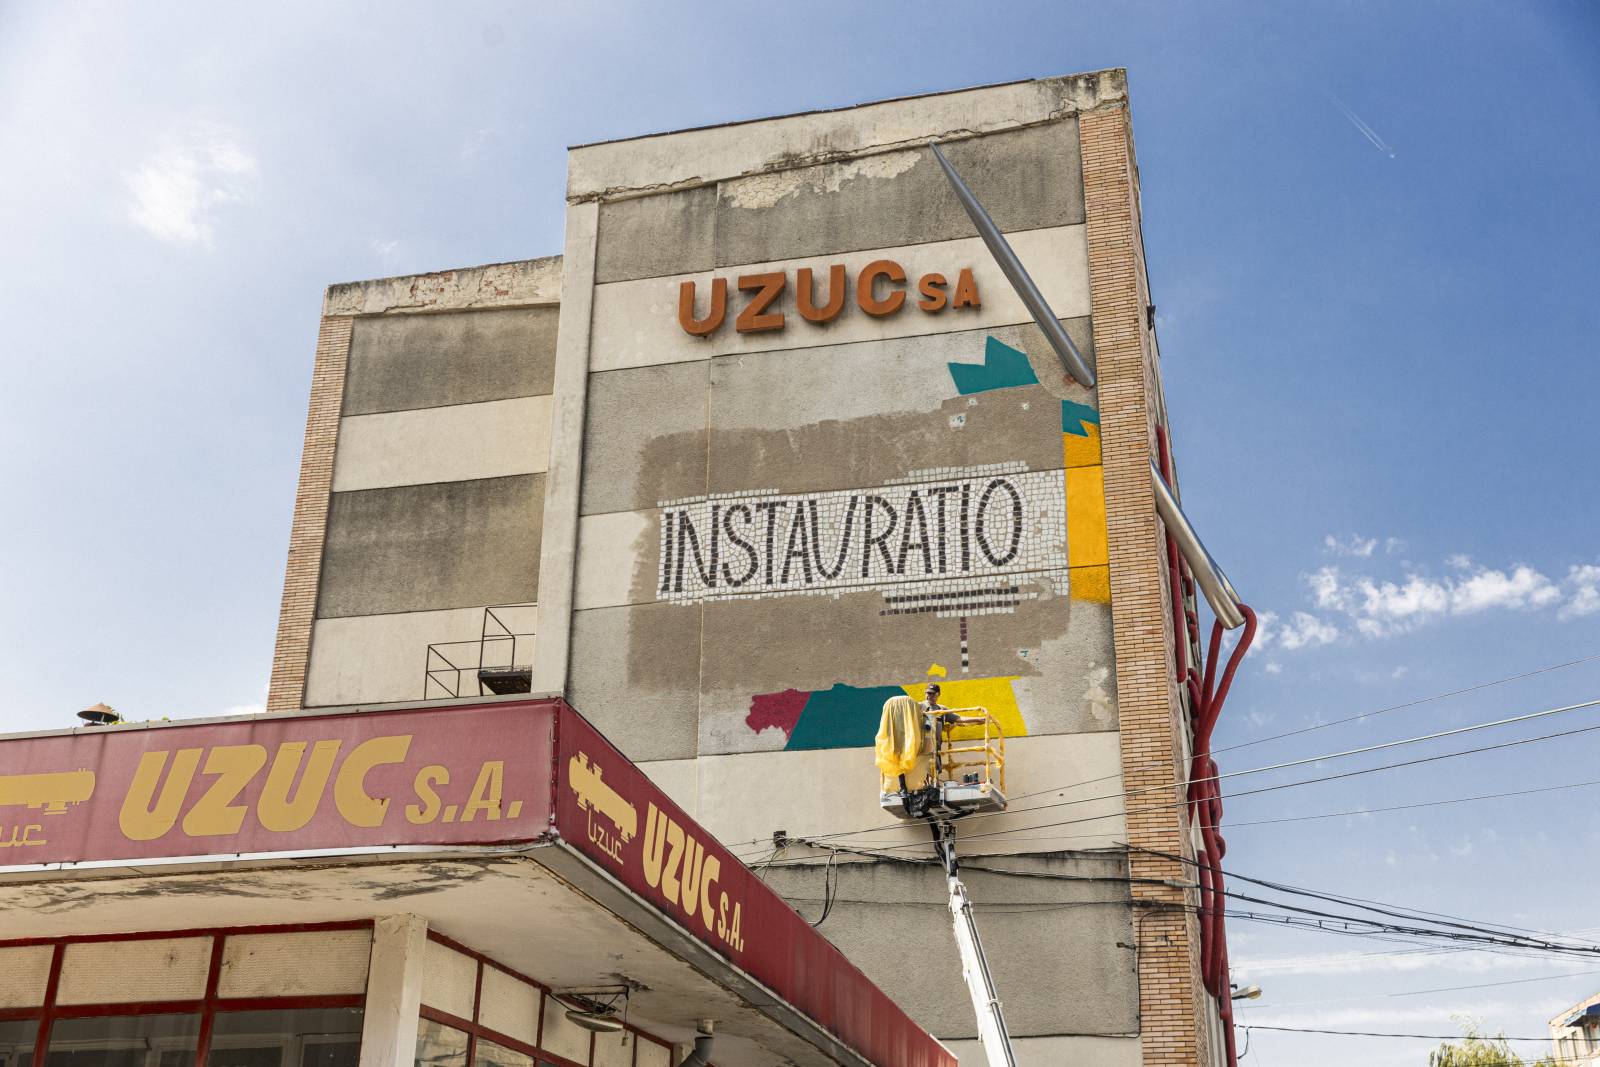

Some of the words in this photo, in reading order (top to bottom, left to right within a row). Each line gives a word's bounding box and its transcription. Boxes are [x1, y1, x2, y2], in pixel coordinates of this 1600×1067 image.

[678, 259, 907, 338] UZUC
[917, 267, 981, 313] SA
[660, 479, 1022, 593] INSTAURATIO
[119, 735, 412, 841] UZUC
[405, 761, 523, 824] S.A.
[588, 811, 624, 865] UZUC
[642, 801, 721, 931] UZUC
[717, 892, 745, 953] S.A.
